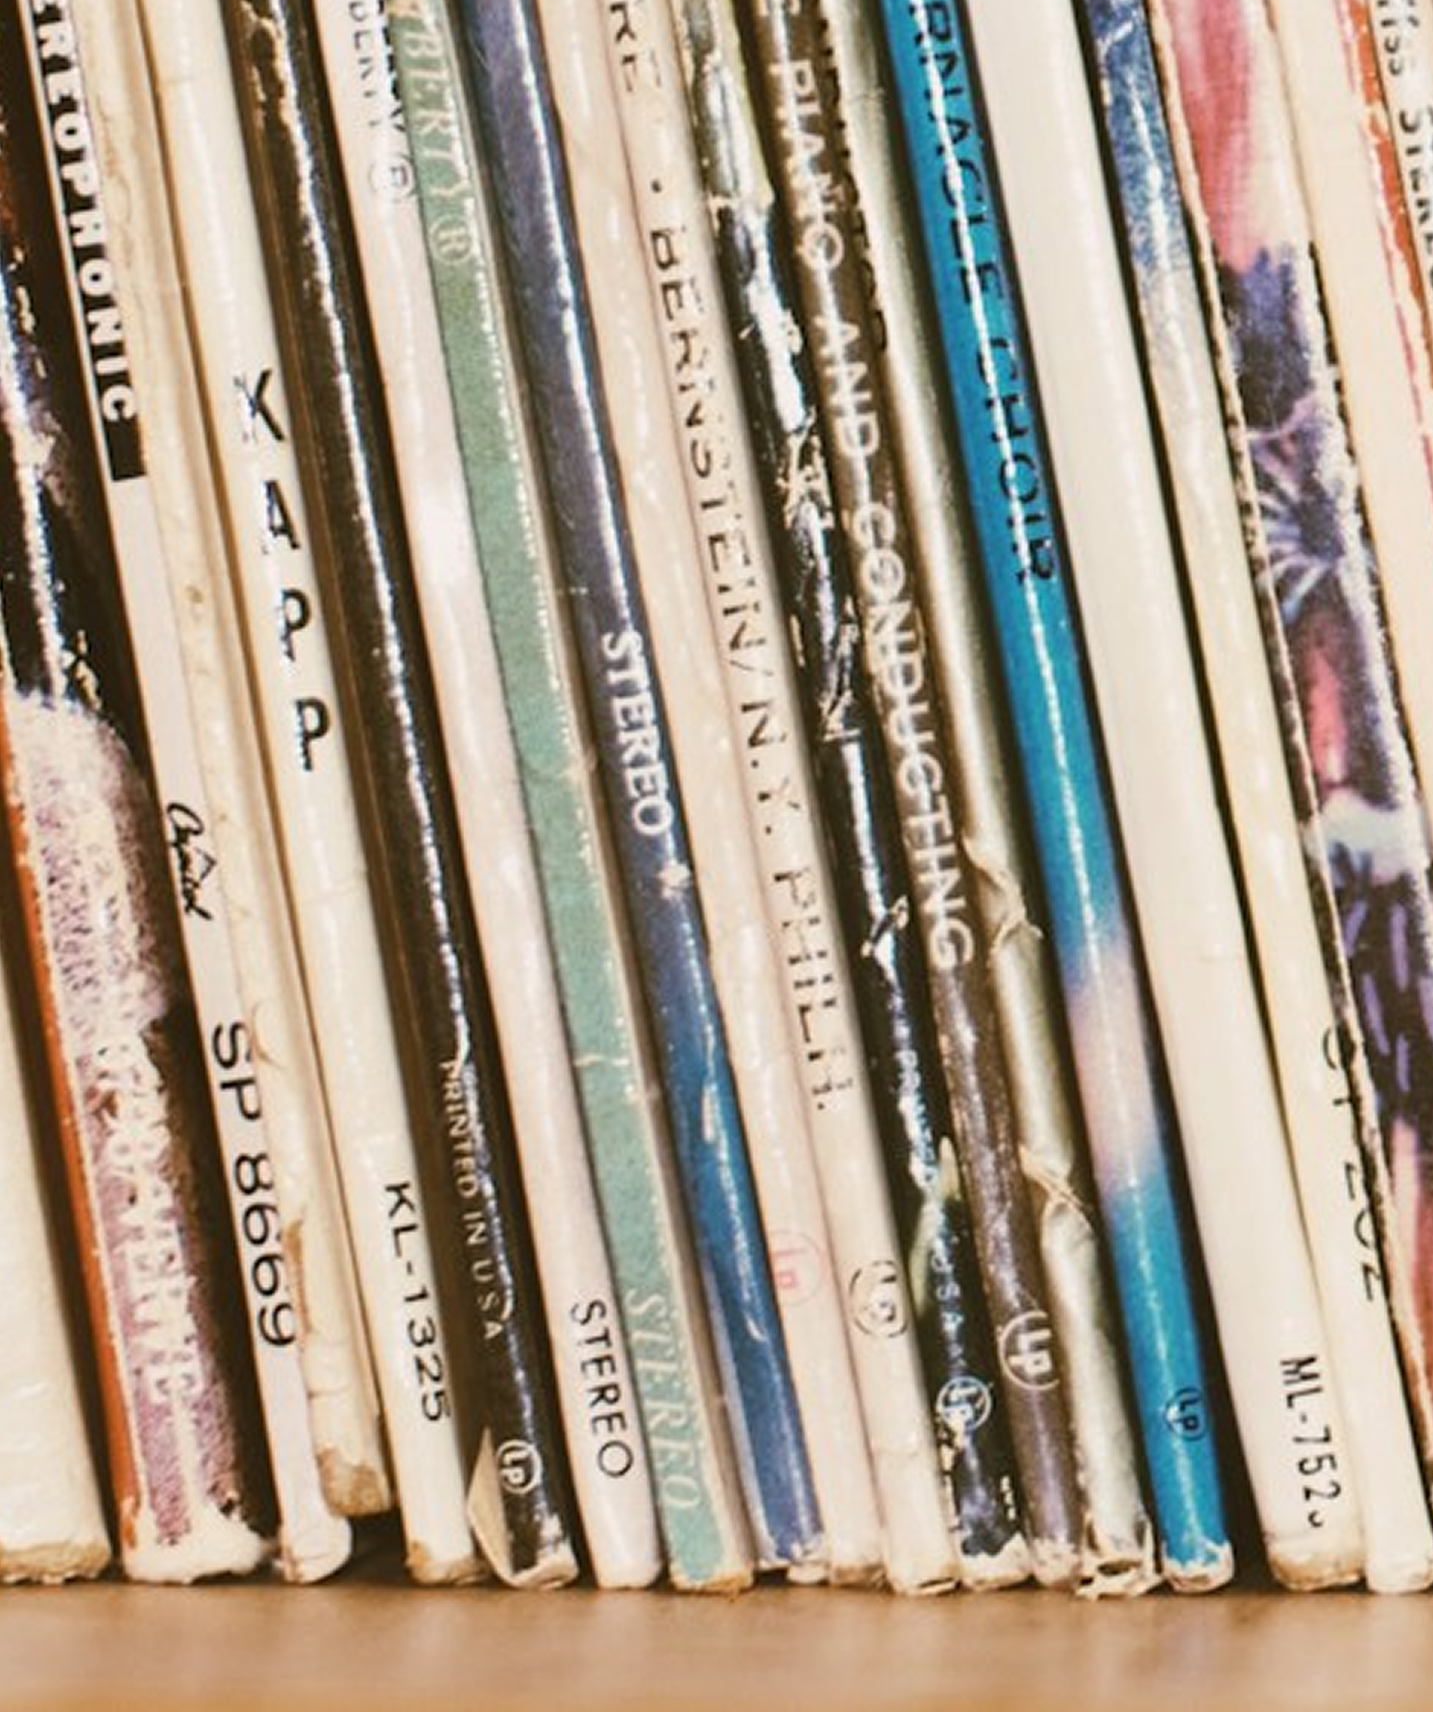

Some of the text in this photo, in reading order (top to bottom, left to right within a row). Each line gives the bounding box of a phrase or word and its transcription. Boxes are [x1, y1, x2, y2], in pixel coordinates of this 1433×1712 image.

[765, 60, 845, 272] PIANO
[811, 313, 882, 460] AND
[974, 337, 1056, 586] CHOIR
[600, 631, 673, 837] STEREO
[846, 500, 974, 971] CONDUCTING
[211, 1022, 297, 1347] SP 8669
[439, 1063, 478, 1199] PRINTED
[460, 1213, 484, 1246] IN
[386, 1182, 450, 1422] KL-1325
[571, 1301, 634, 1478] STEREO
[624, 1288, 702, 1509] STEREO
